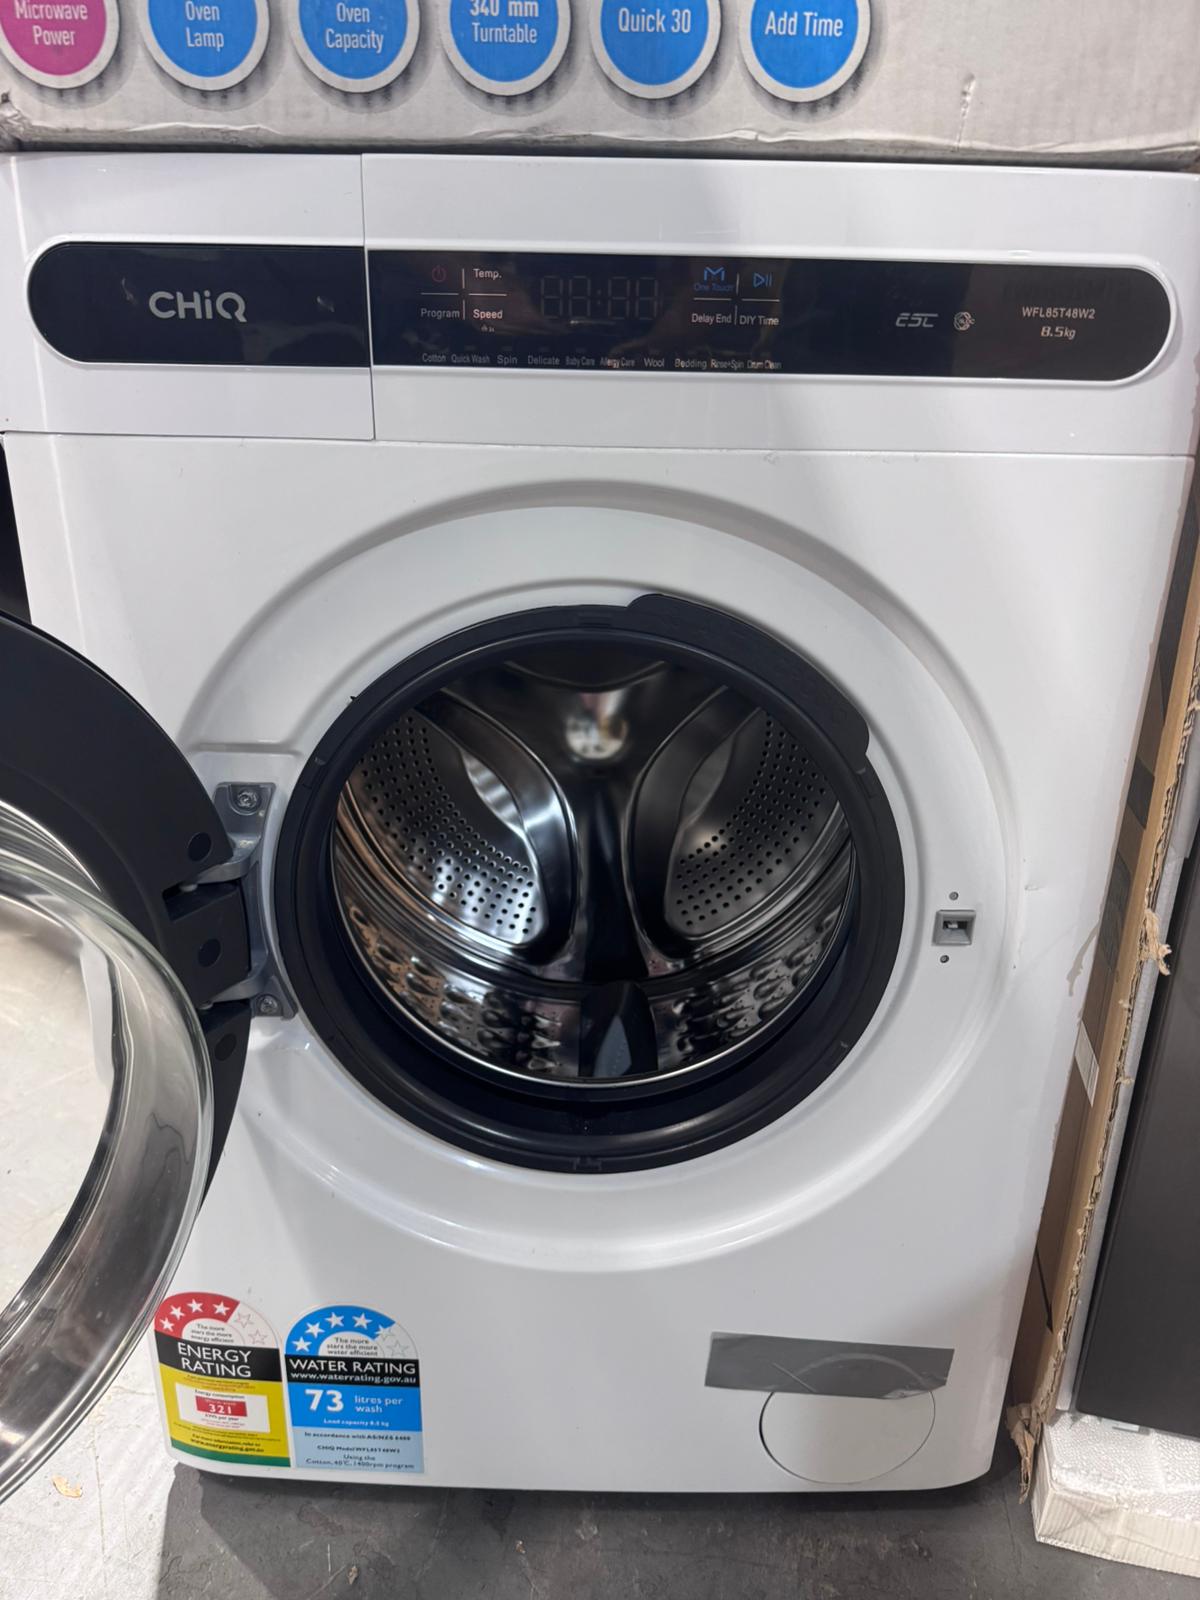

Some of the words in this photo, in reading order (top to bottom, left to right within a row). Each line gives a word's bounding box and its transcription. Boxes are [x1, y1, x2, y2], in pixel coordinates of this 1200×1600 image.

[15, 1, 88, 20] Microwave
[185, 2, 220, 21] Oven
[336, 7, 370, 23] Oven
[470, 0, 499, 17] 340
[507, 2, 539, 18] mm
[618, 8, 666, 33] Quick
[671, 10, 691, 34] 30
[765, 11, 797, 36] Add
[803, 12, 843, 37] Time
[33, 26, 76, 46] Power
[472, 22, 537, 44] Turntable
[186, 28, 224, 52] Lamp
[325, 28, 384, 54] Capacity
[473, 268, 502, 281] Temp.
[420, 308, 460, 319] Program
[473, 309, 503, 319] Speed
[691, 313, 714, 325] Delay
[716, 314, 731, 324] End
[1022, 306, 1096, 320] WFL85T48W2
[739, 315, 755, 325] DIY
[758, 316, 779, 326] Time
[422, 353, 446, 363] Cotton
[451, 353, 470, 363] Quick
[471, 354, 490, 364] Wash
[497, 355, 518, 365] Spin
[528, 355, 560, 366] Delicate
[644, 358, 665, 368] Wool
[674, 358, 708, 370] Bedding
[178, 1342, 252, 1364] ENERGY
[181, 1357, 251, 1377] RATING
[290, 1359, 347, 1372] WATER
[353, 1361, 416, 1375] RATING
[290, 1372, 416, 1385] www.waterrating.gov.au
[304, 1388, 344, 1412] 73
[354, 1395, 382, 1404] litres
[385, 1398, 403, 1406] per
[209, 1404, 232, 1415] 321
[355, 1404, 383, 1413] wash
